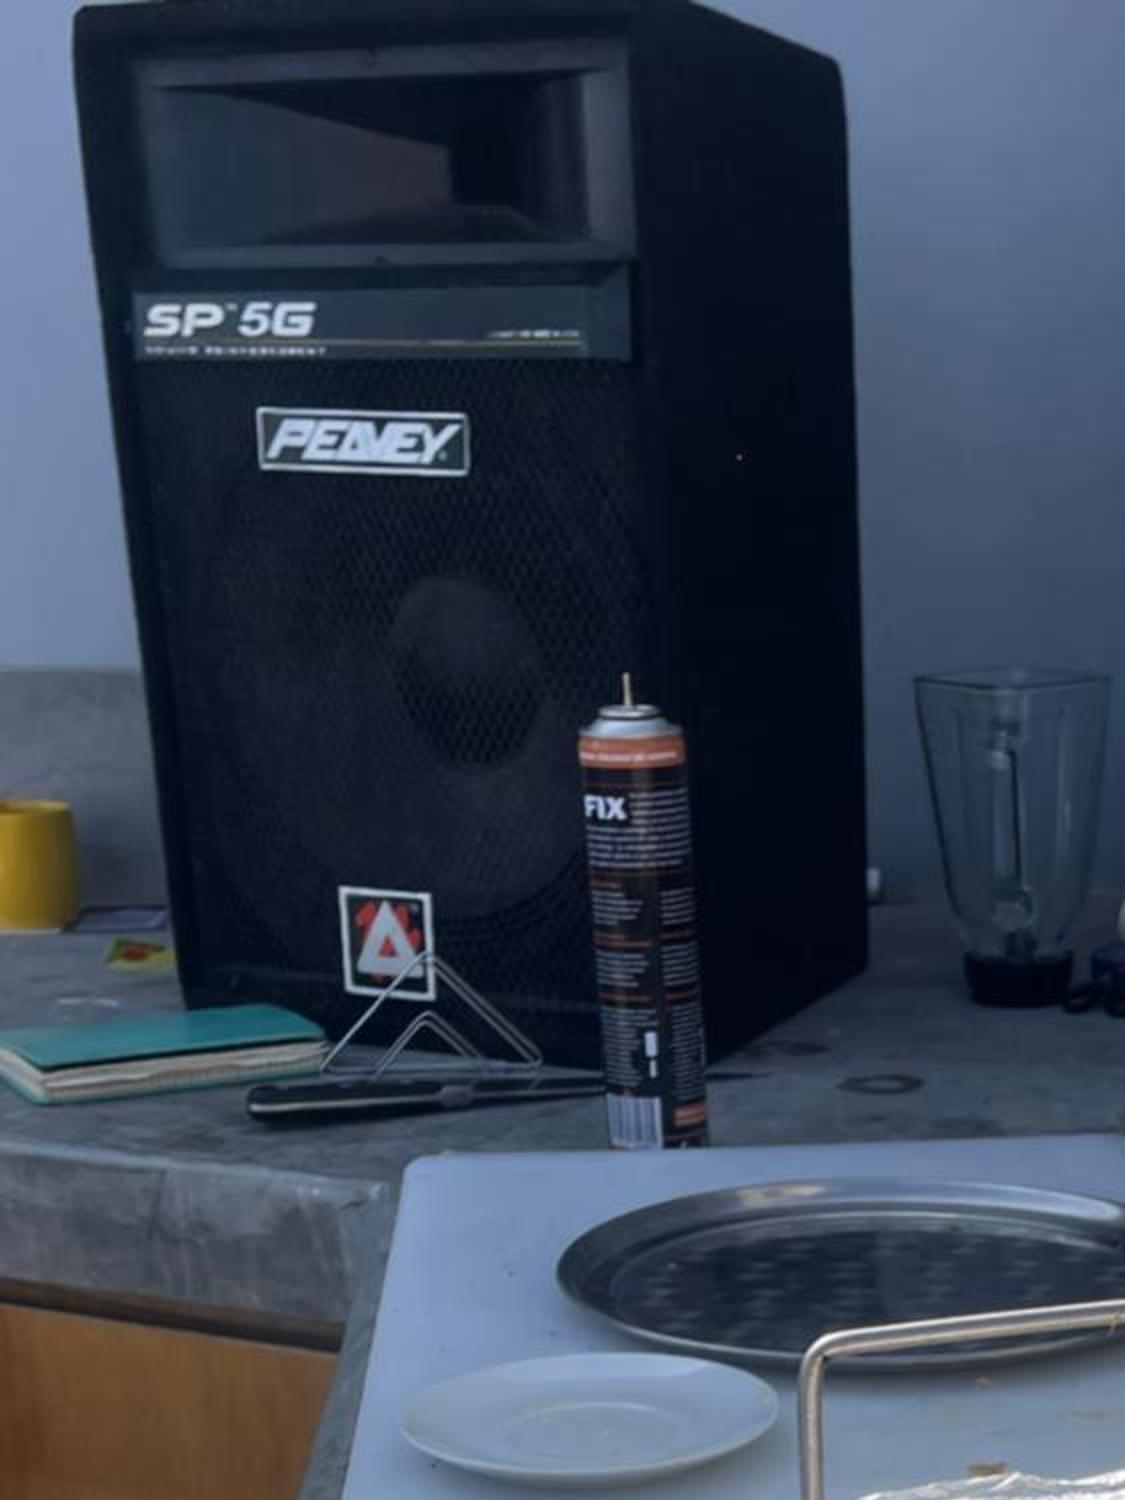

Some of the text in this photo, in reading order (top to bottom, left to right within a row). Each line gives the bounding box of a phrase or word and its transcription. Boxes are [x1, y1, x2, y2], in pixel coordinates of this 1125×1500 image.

[144, 302, 316, 337] SP 5G
[266, 418, 461, 465] PEAVEY
[583, 794, 628, 820] FIX
